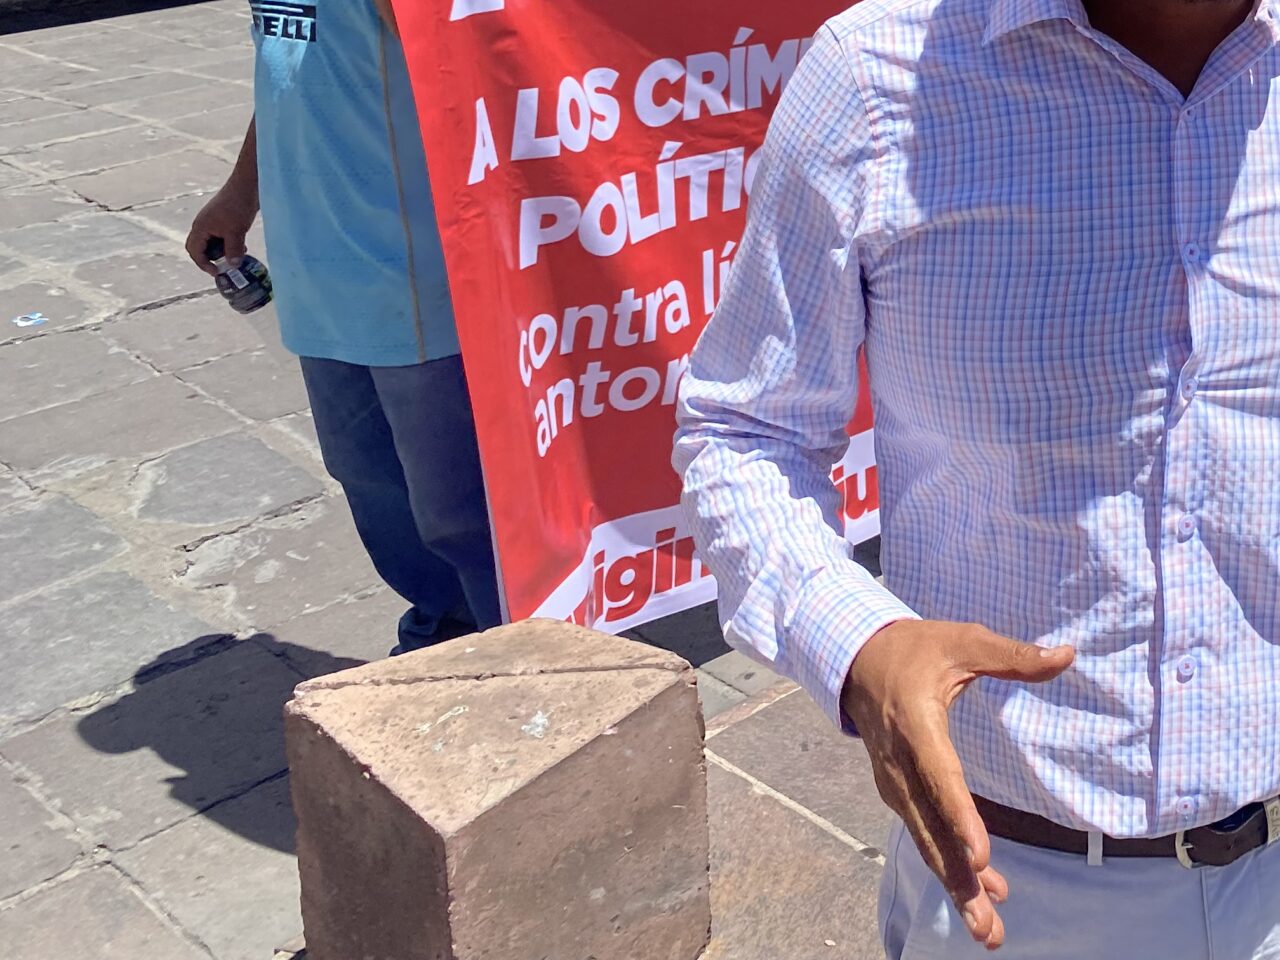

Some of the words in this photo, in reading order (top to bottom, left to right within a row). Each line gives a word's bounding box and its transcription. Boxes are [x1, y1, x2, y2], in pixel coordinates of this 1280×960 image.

[467, 96, 499, 186] A
[510, 67, 620, 162] LOS
[633, 26, 816, 128] CRÍM
[518, 279, 691, 388] contra
